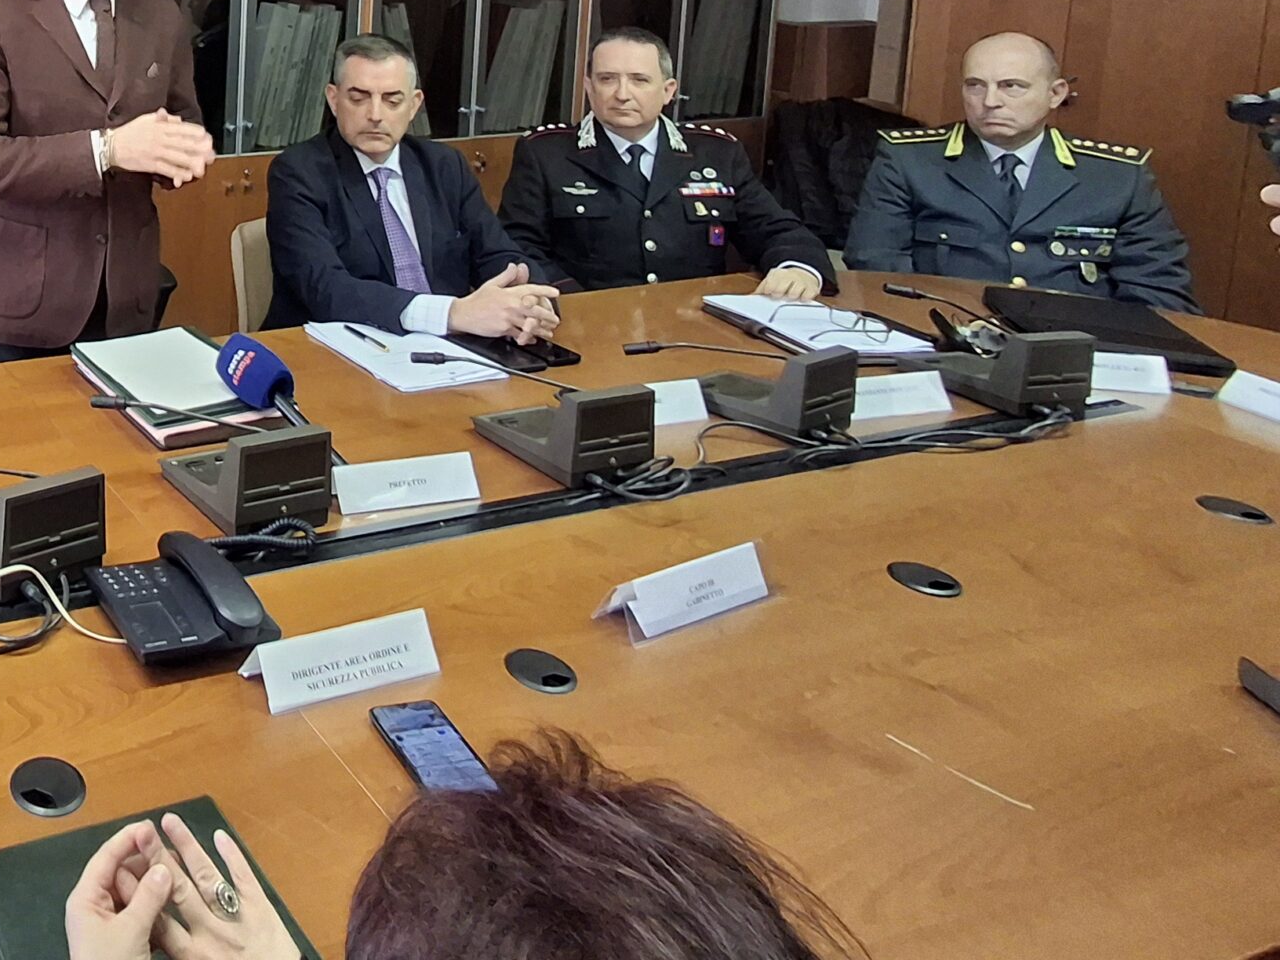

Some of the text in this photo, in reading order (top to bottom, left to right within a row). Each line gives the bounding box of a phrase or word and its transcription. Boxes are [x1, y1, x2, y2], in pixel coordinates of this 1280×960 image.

[227, 349, 246, 375] certa
[232, 351, 256, 386] stampa
[685, 588, 725, 608] GABINETTO
[688, 581, 707, 594] CAPO
[291, 643, 411, 681] DIRIGENTE AREA ORDINE E
[307, 660, 404, 692] SICUREZZA PUBBLICA
